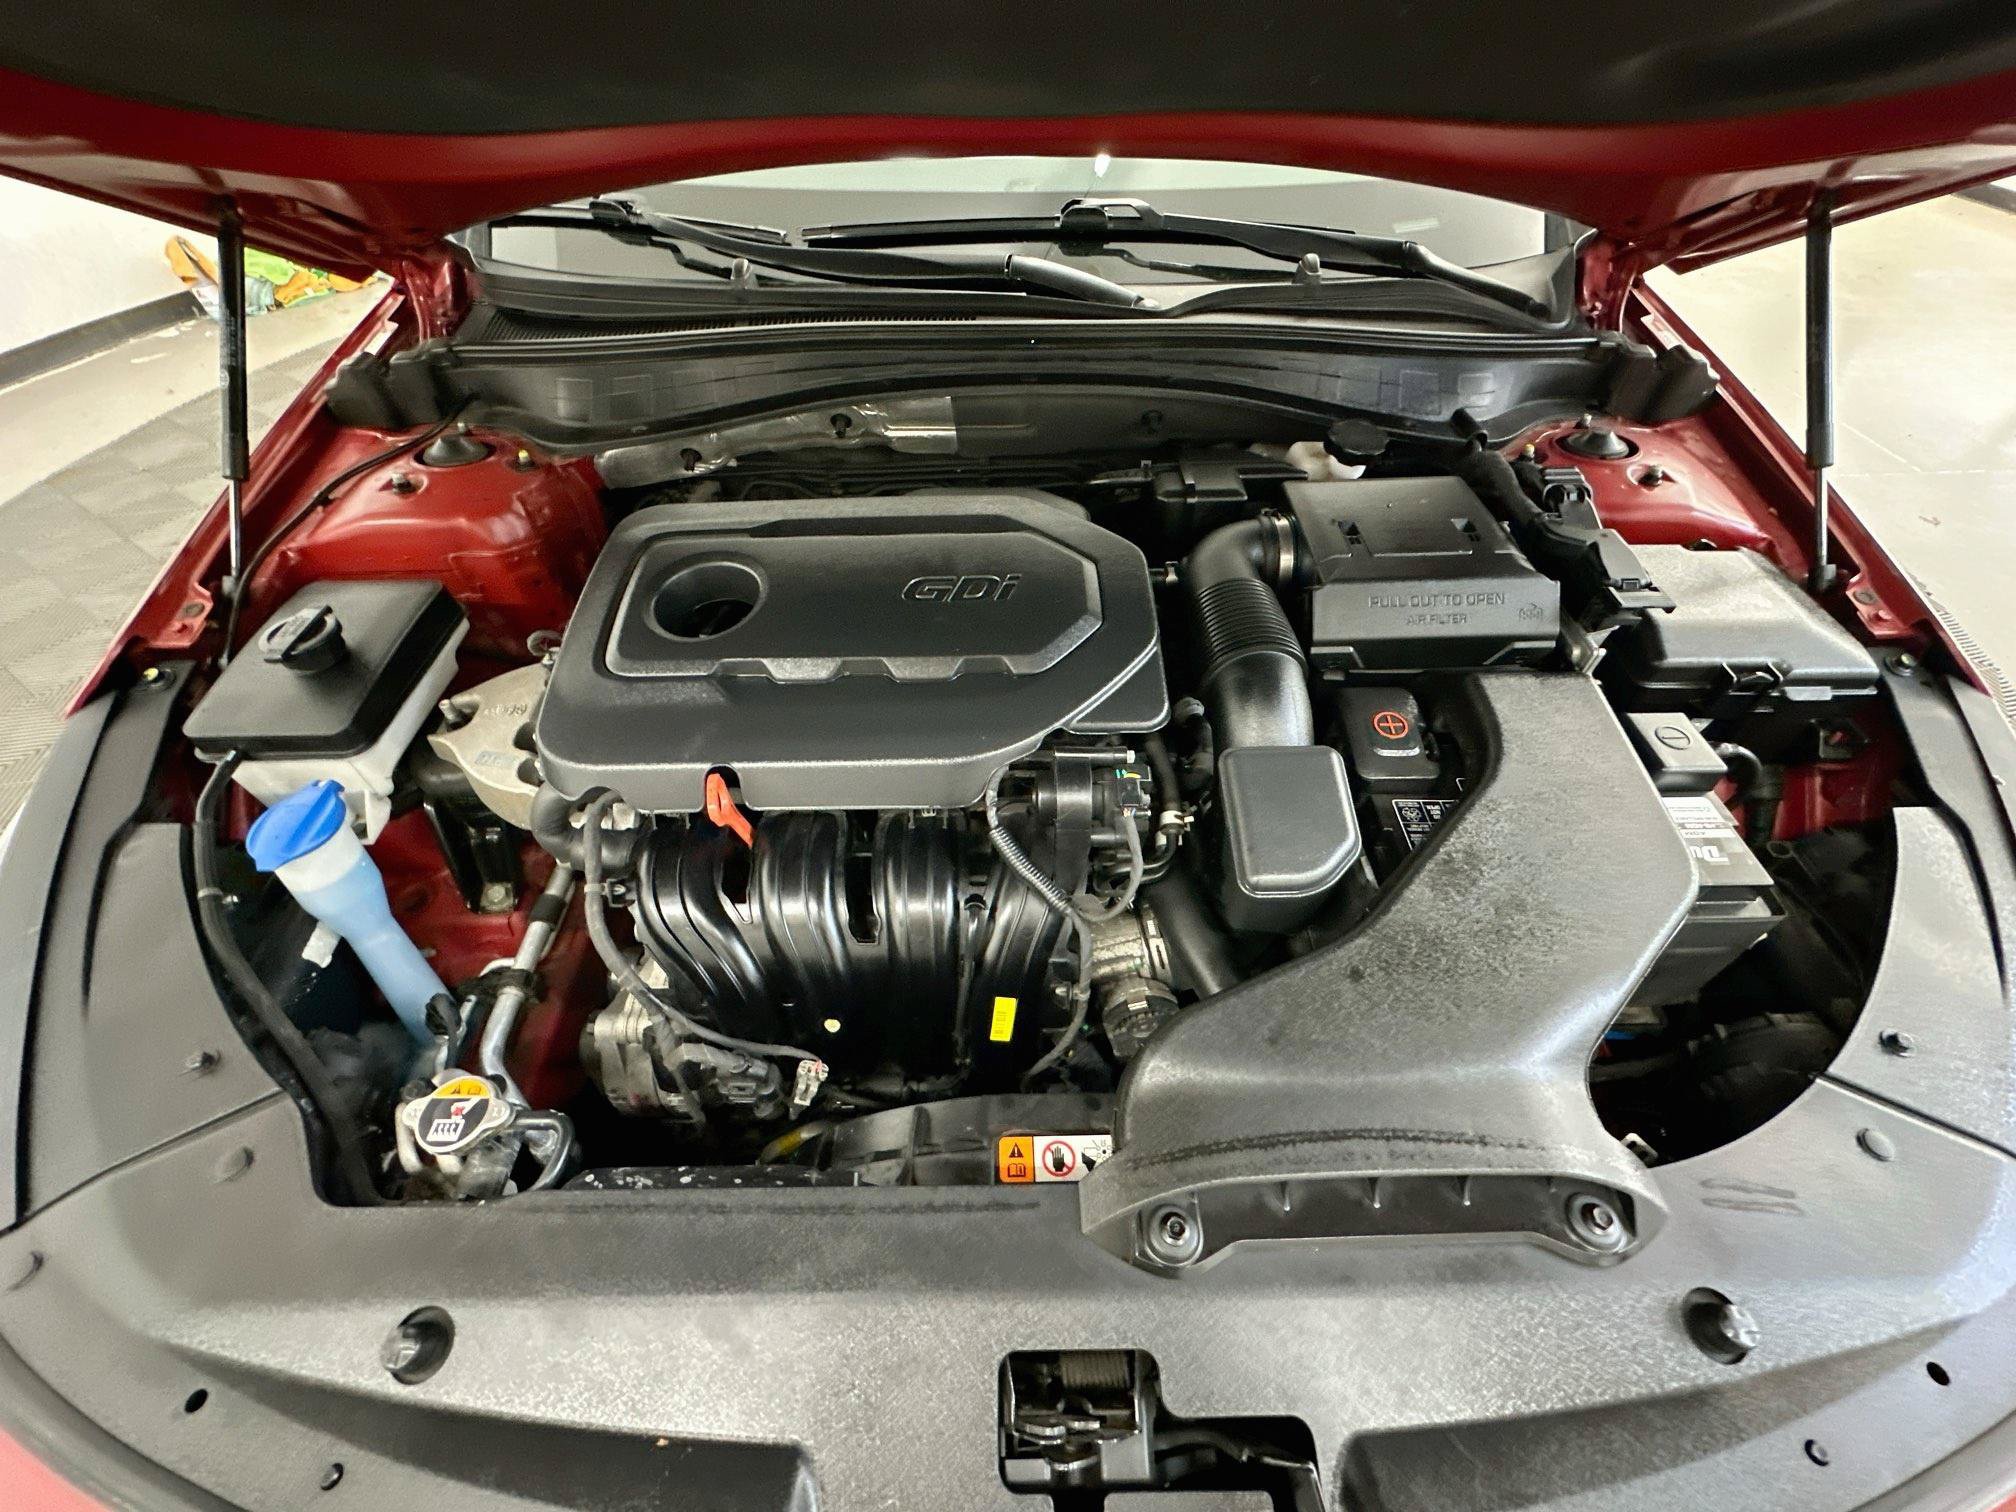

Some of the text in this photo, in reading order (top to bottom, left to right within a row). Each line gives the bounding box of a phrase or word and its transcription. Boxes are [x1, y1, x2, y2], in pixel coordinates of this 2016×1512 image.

[901, 573, 1022, 602] GDi
[1368, 592, 1505, 608] PULL OUT TO OPEN
[1406, 613, 1467, 625] AIR FILTER
